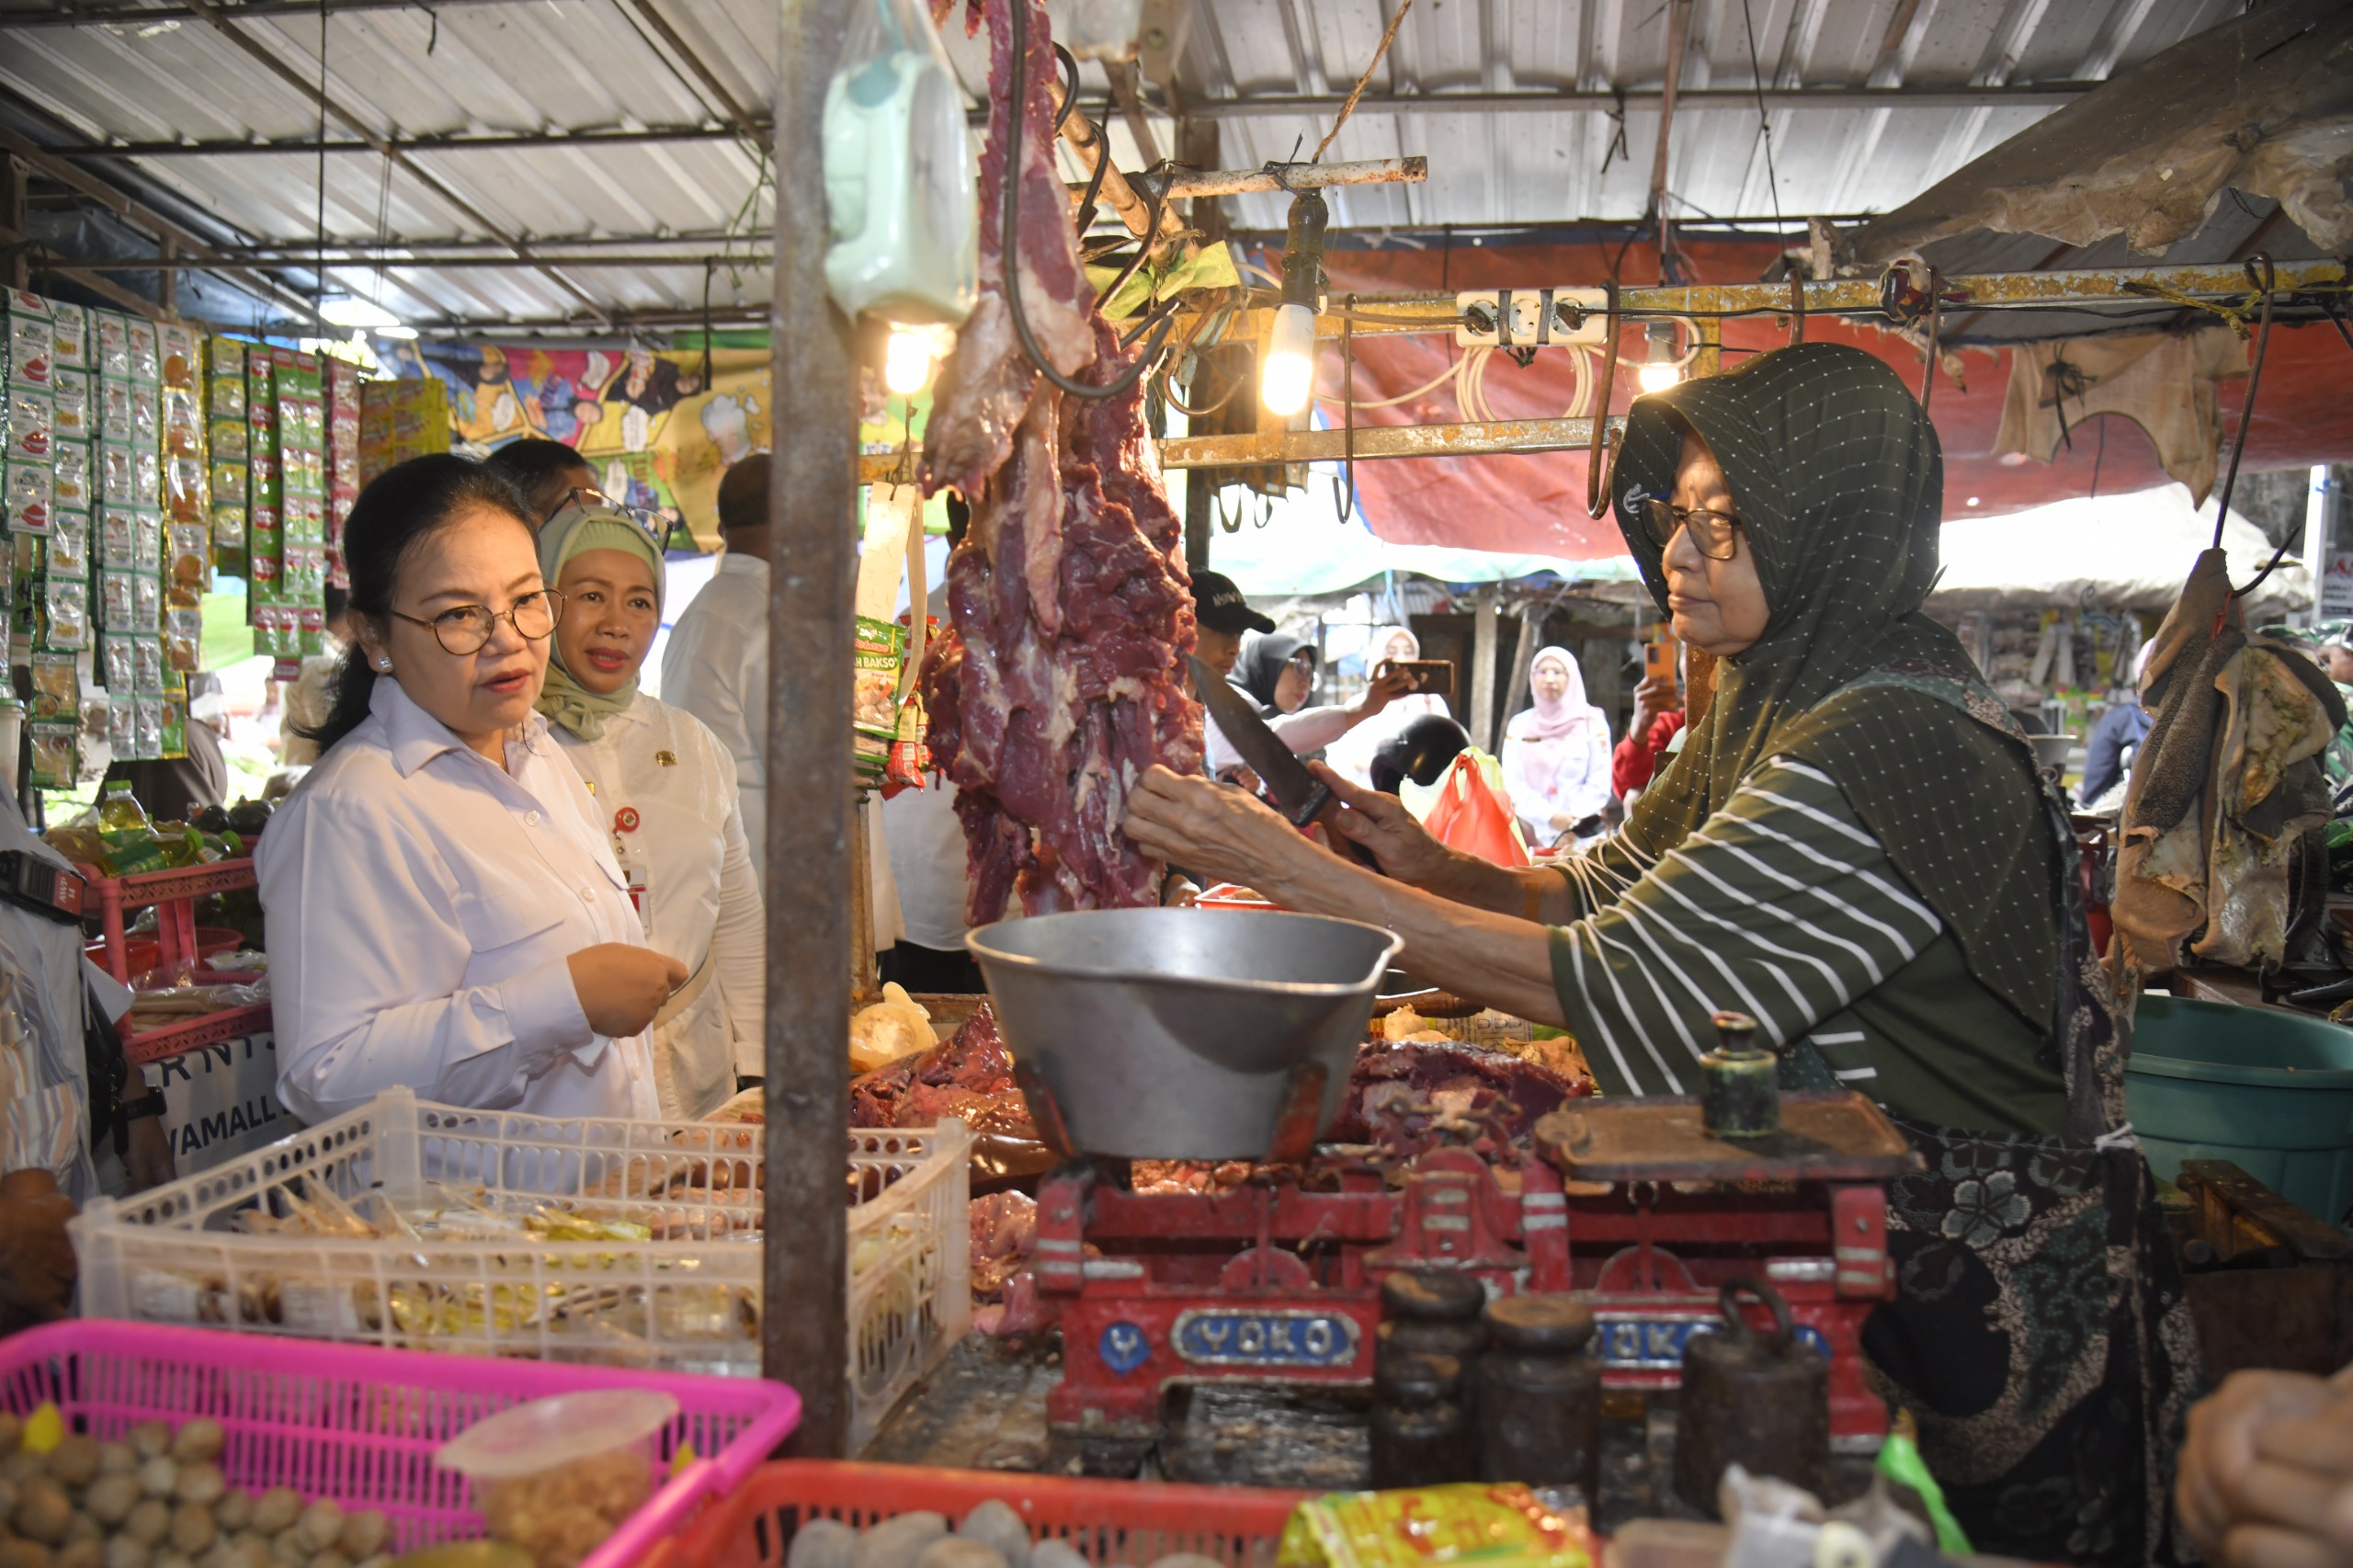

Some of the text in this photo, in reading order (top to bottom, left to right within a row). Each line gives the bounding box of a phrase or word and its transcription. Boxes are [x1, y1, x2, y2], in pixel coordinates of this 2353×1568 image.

[59, 877, 68, 903] AWP
[1200, 1320, 1333, 1357] YOKO
[1586, 1323, 1715, 1360] OK
